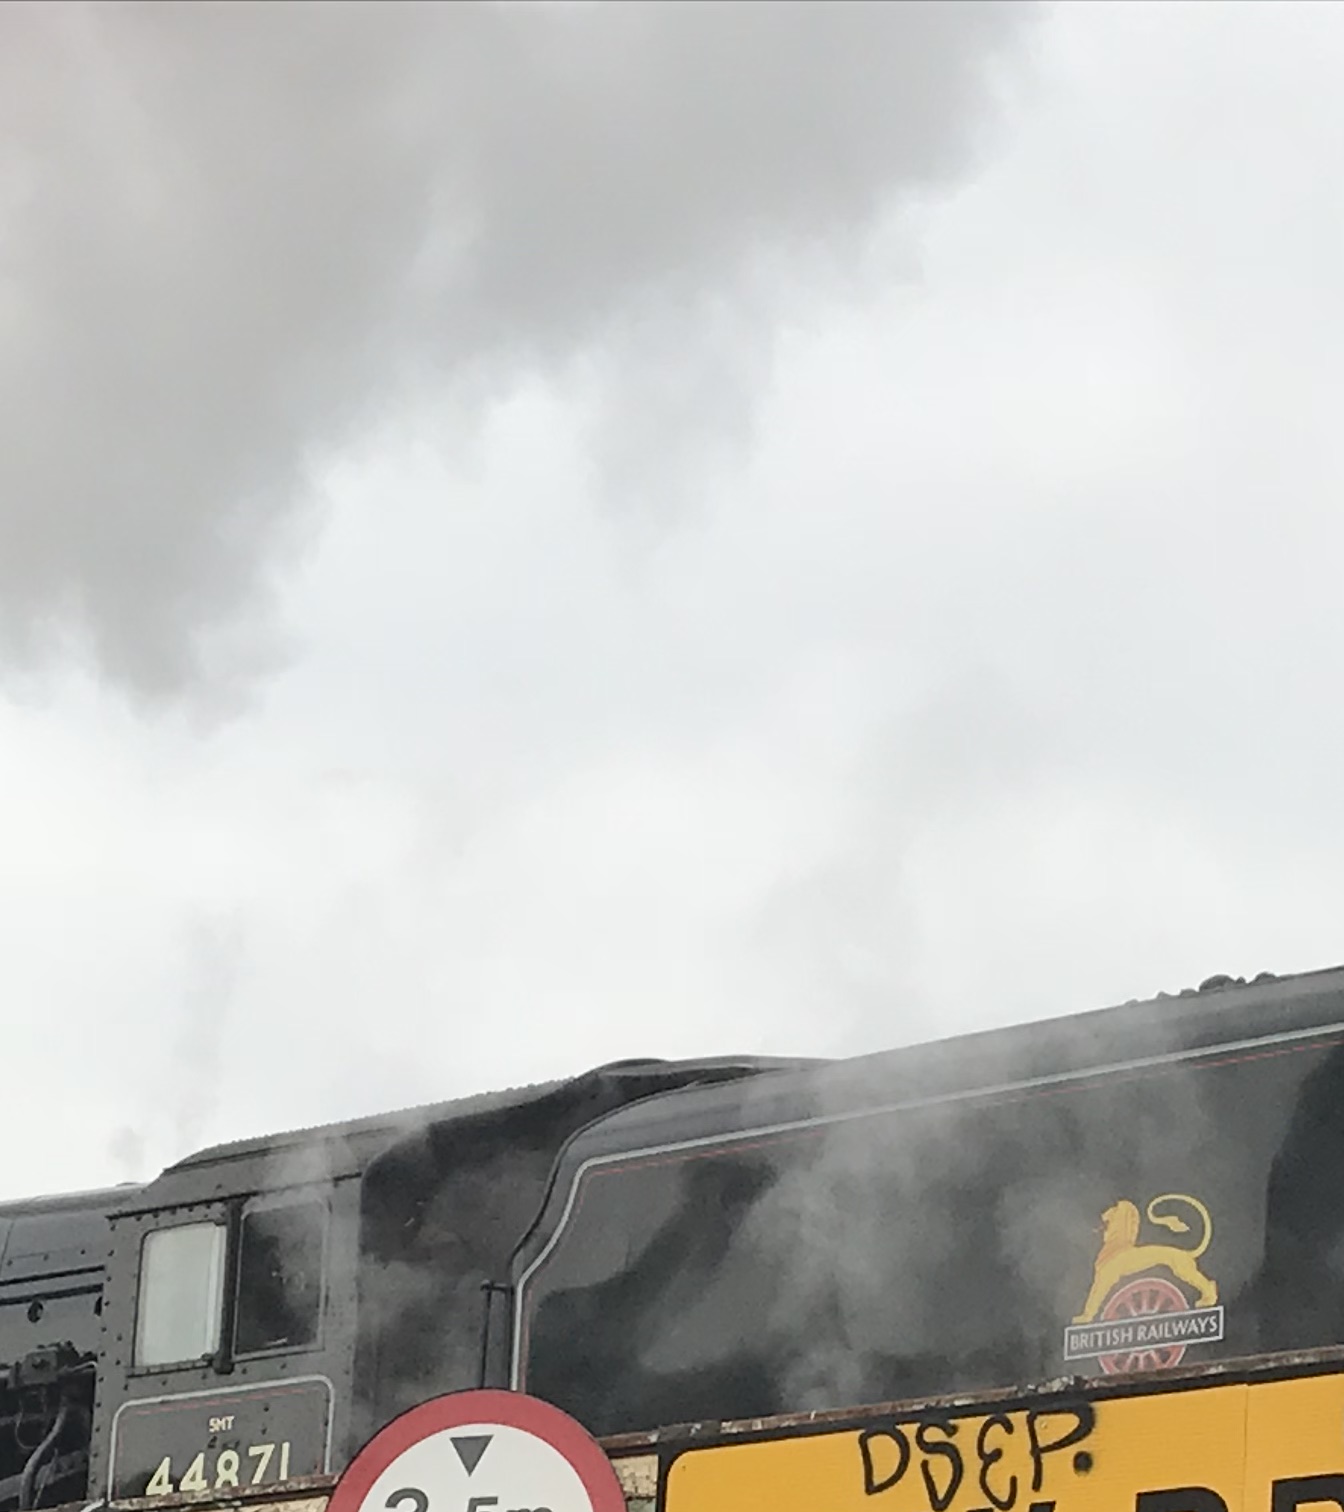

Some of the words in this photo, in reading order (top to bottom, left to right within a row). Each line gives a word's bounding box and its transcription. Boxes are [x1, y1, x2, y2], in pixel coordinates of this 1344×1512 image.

[1069, 1328, 1133, 1351] BRITISH
[1136, 1315, 1218, 1342] RAILWAYS
[145, 1441, 291, 1496] 44871
